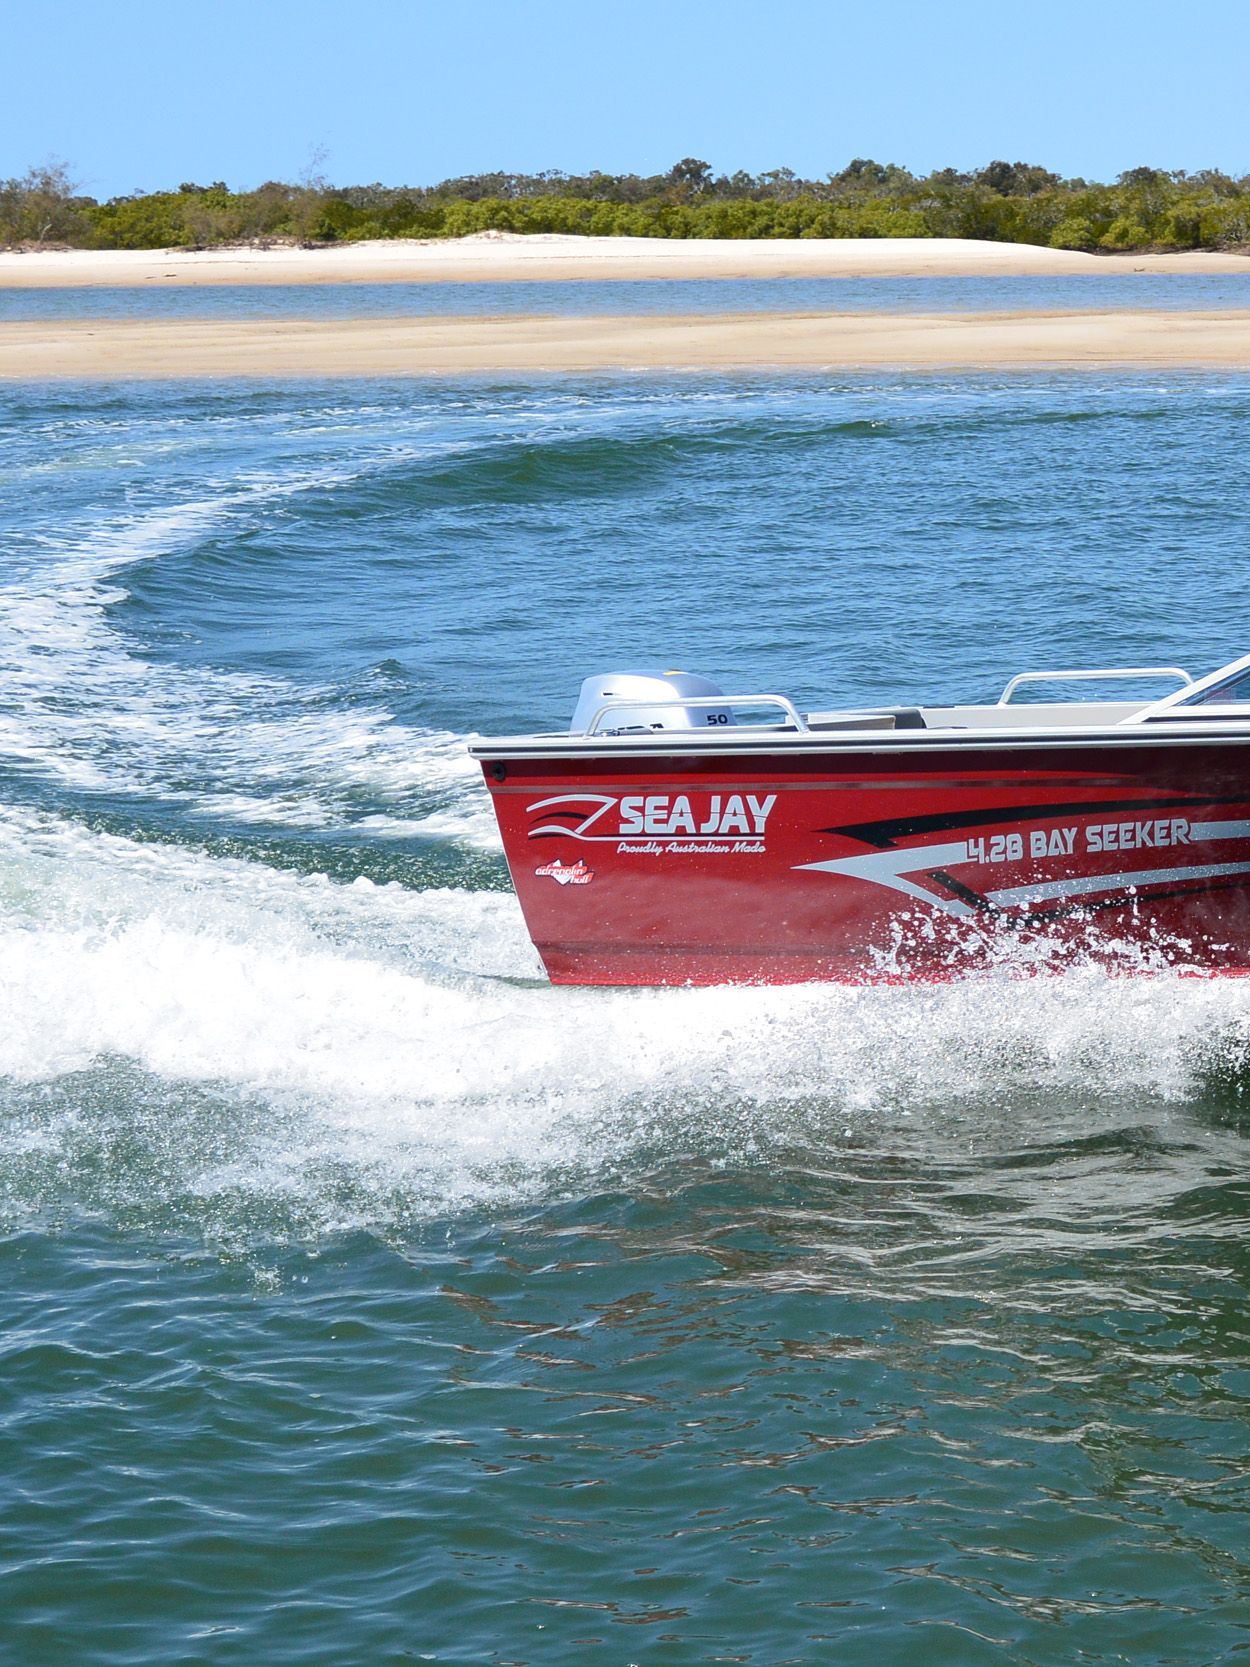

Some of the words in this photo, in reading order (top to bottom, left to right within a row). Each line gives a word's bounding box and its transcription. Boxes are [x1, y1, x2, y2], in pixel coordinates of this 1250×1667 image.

[706, 714, 728, 726] 50
[619, 795, 697, 834] SEA
[700, 795, 778, 834] JAY
[617, 841, 664, 856] Proudly
[665, 841, 730, 854] Australian
[731, 841, 767, 854] Made
[968, 833, 1023, 864] 4.28
[1030, 827, 1078, 858] BAY
[1085, 818, 1192, 853] SEEKER
